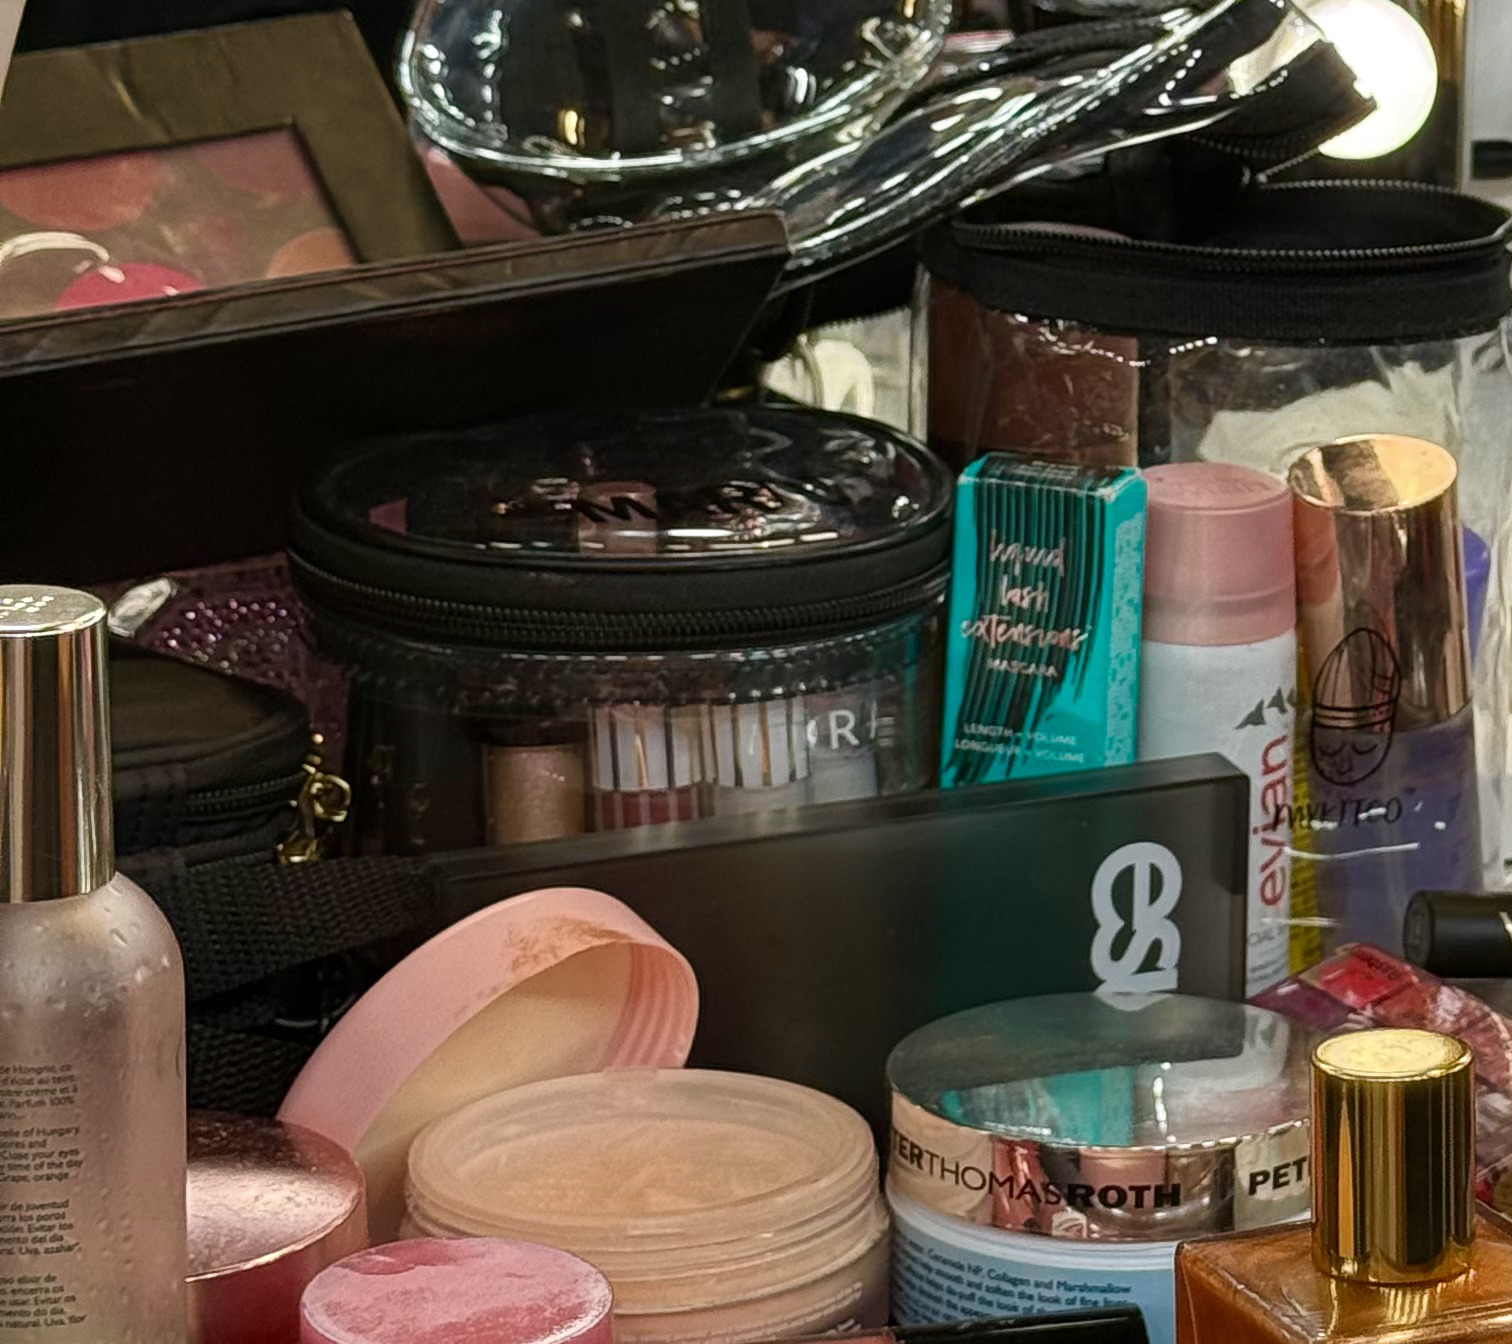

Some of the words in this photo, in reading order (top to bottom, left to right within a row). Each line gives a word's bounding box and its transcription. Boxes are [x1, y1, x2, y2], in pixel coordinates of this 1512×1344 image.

[989, 527, 1065, 577] liquid
[1001, 574, 1050, 613] lash
[987, 658, 1058, 678] MASCARA
[1252, 734, 1291, 907] evian
[1247, 1156, 1312, 1196] PET
[987, 1268, 1033, 1288] Collagen
[1033, 1278, 1054, 1290] and
[1056, 1280, 1132, 1294] Marshmallow
[1037, 1292, 1062, 1306] look
[1064, 1295, 1078, 1307] of
